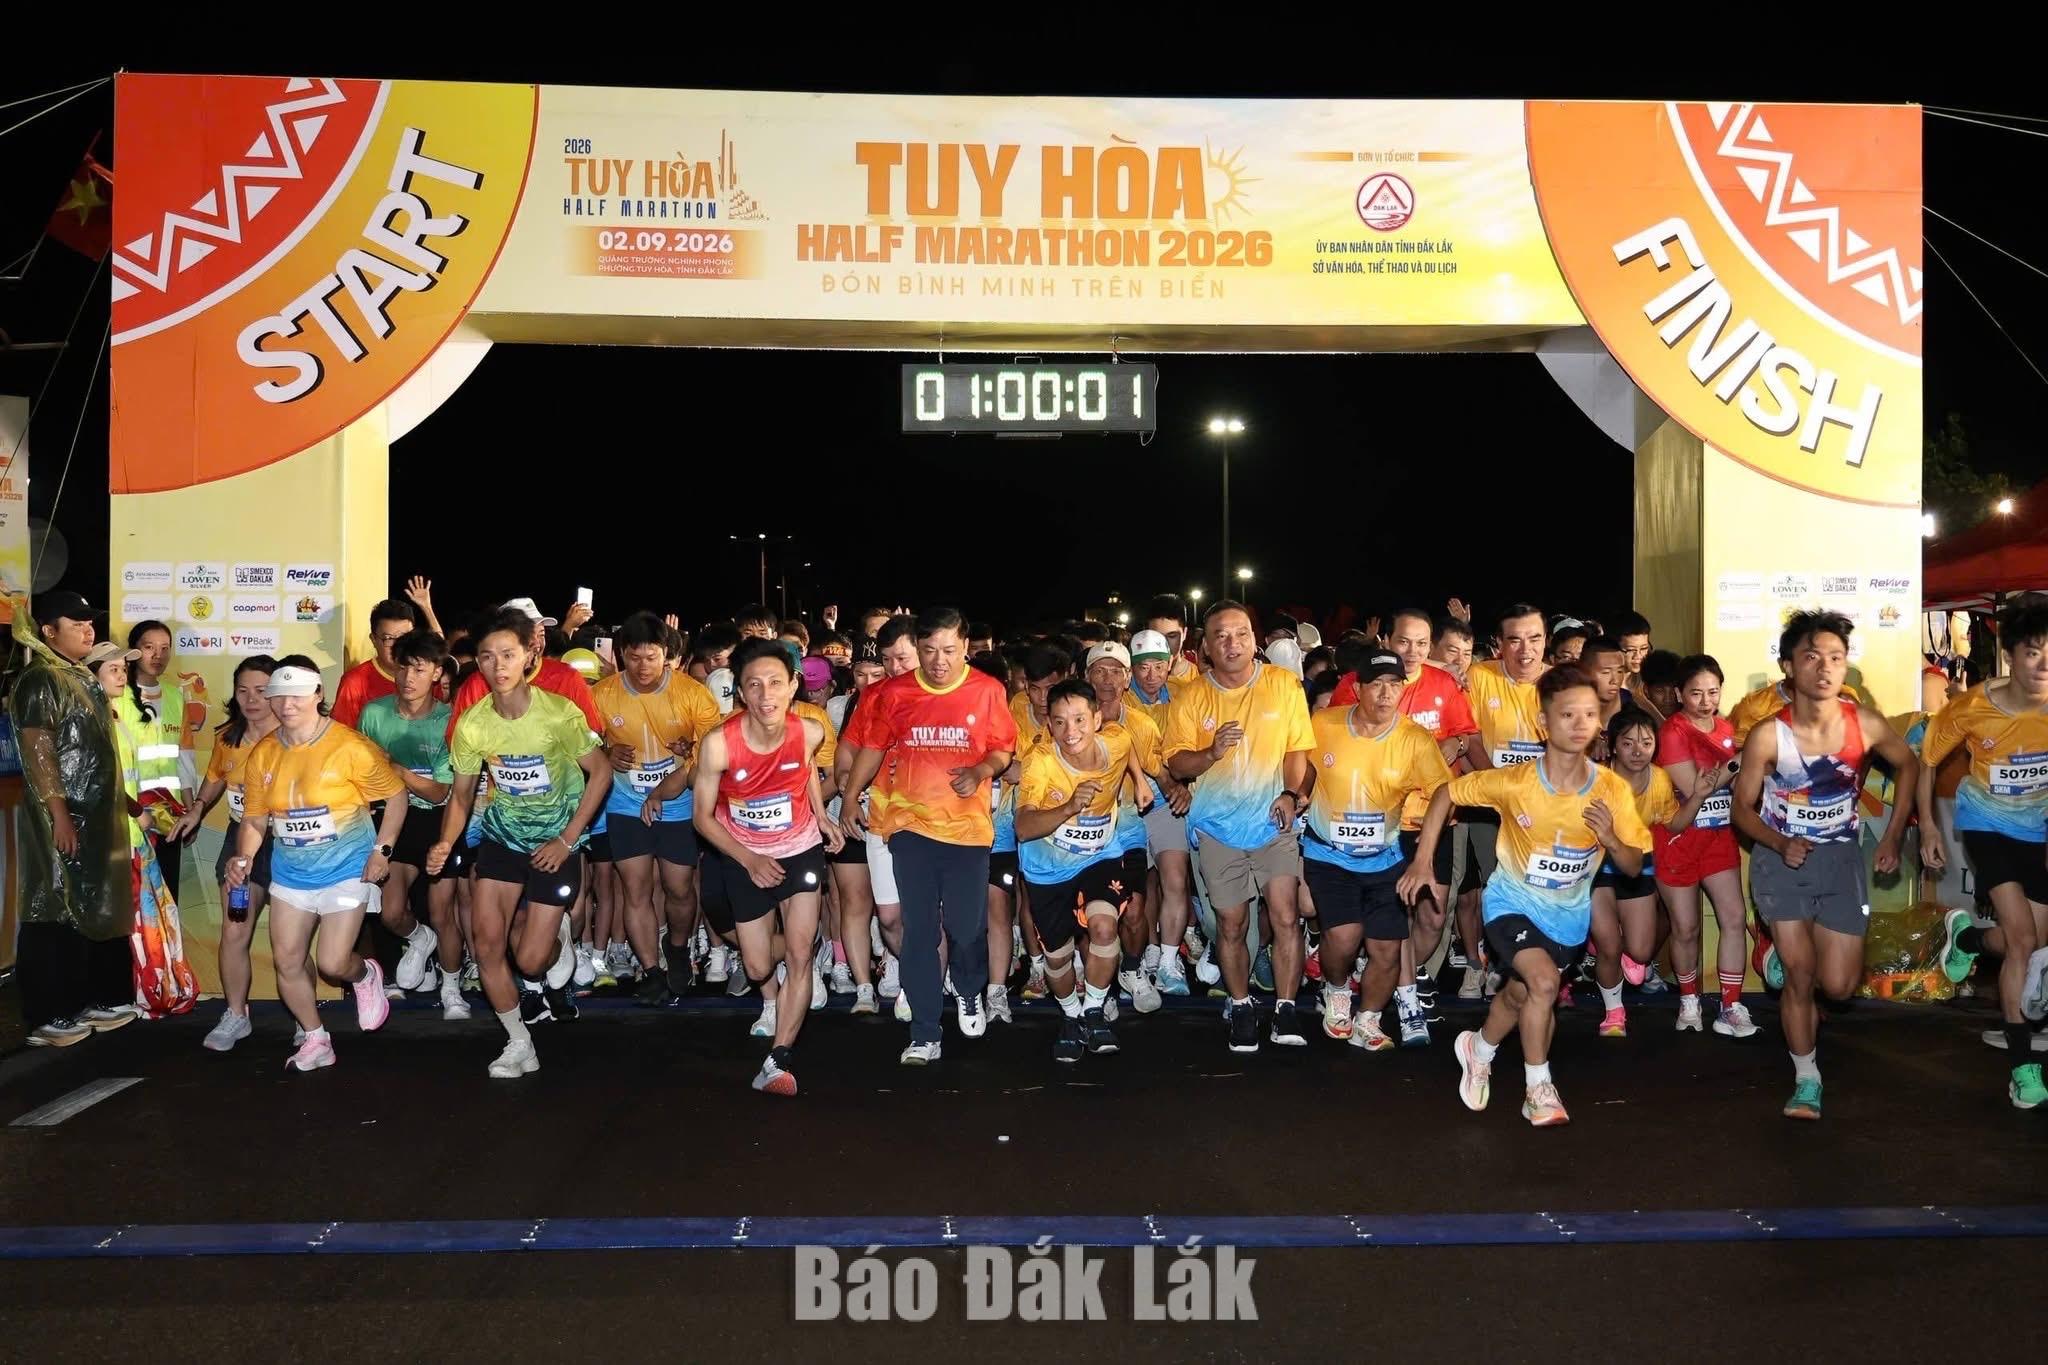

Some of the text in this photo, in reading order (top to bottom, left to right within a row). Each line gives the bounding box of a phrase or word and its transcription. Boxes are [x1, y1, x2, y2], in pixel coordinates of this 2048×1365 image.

[564, 138, 591, 154] 2026
[564, 151, 715, 199] TUY HÒA
[856, 133, 1207, 219] TUY HÒA
[564, 198, 717, 219] HALF MARATHON
[598, 231, 734, 254] 02.09.2026
[797, 223, 1274, 268] HALF MARATHON 2026
[1316, 239, 1328, 253] ỦY
[1329, 242, 1347, 253] BAN
[1349, 240, 1374, 253] NHÂN
[1375, 240, 1393, 253] DÂN
[1396, 239, 1415, 253] TỈNH
[237, 127, 484, 404] START
[1313, 260, 1325, 274] SỞ
[1326, 260, 1344, 274] VĂN
[1368, 258, 1385, 274] THỂ
[1387, 262, 1409, 274] THAO
[1411, 259, 1423, 274] VÀ
[1424, 262, 1436, 274] DU
[1438, 262, 1457, 276] LỊCH
[821, 270, 1226, 299] ĐÓN BÌNH MINH TRÊN BIỂN
[1612, 217, 1883, 469] FINISH
[286, 569, 330, 580] ReVive
[1869, 578, 1910, 588] ReVive
[911, 726, 937, 740] TUY
[498, 769, 540, 781] 50024
[1999, 765, 2048, 779] 50796
[1701, 799, 1730, 812] 51039
[1796, 805, 1844, 820] 50966
[739, 807, 782, 819] 50326
[285, 820, 321, 832] 51214
[1338, 826, 1375, 837] 51243
[1064, 828, 1104, 840] 52830
